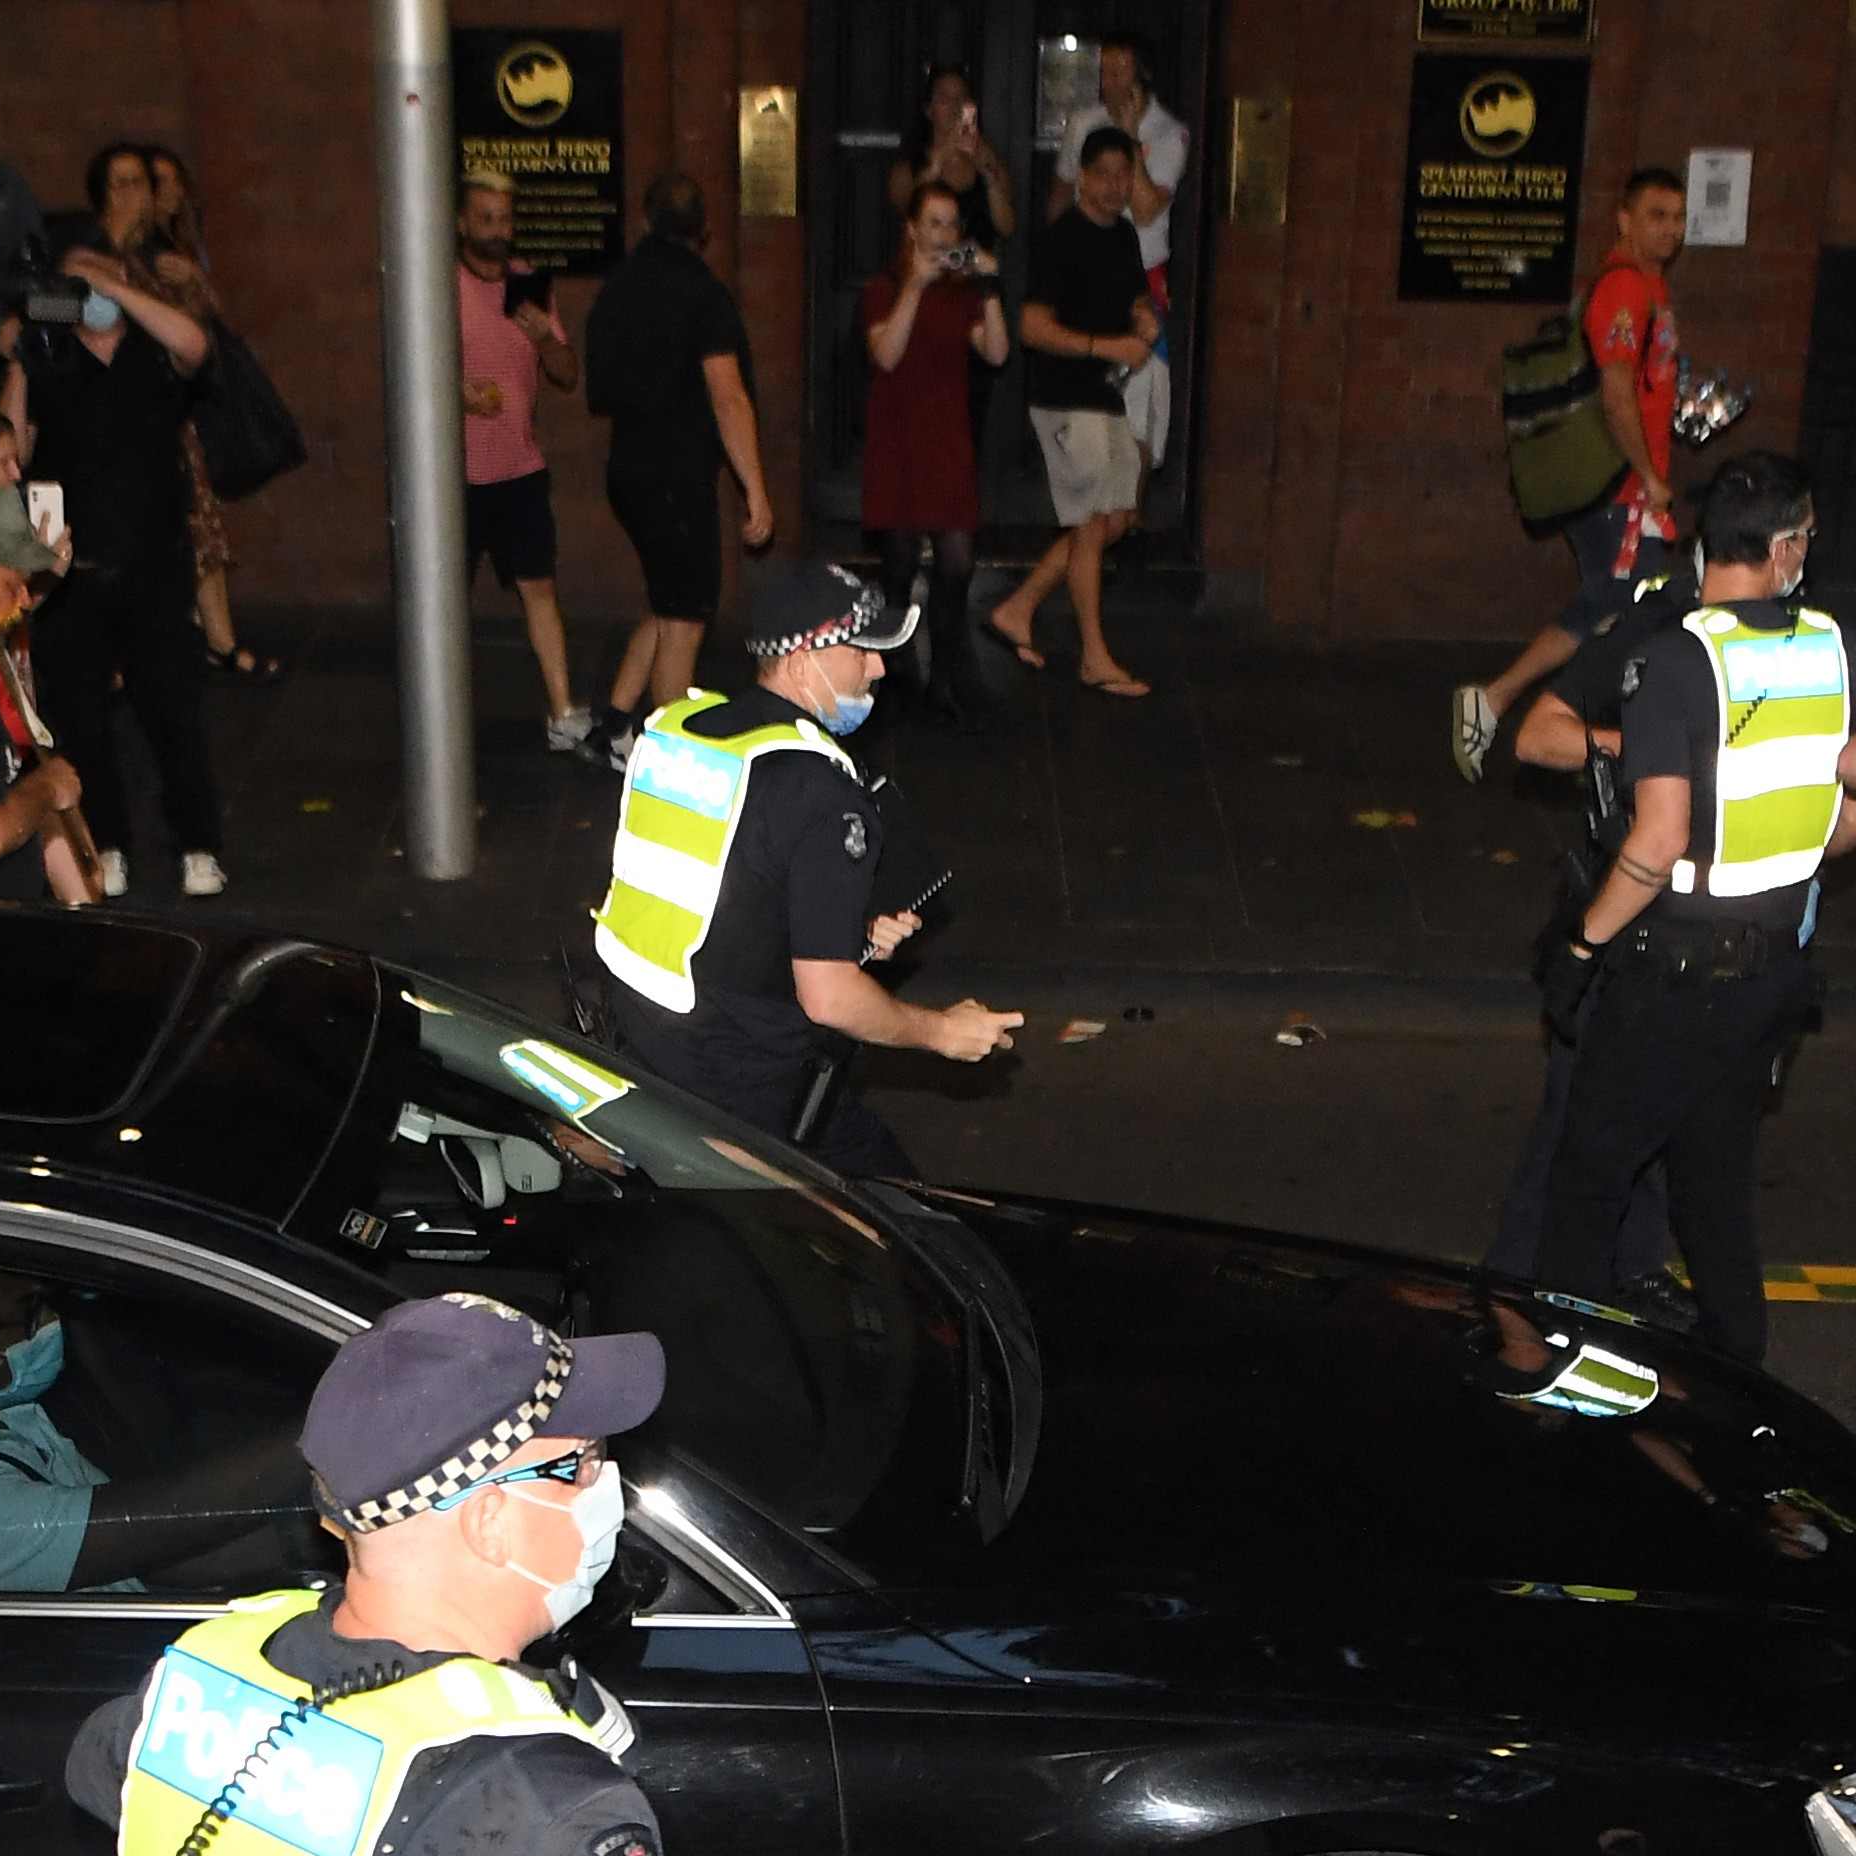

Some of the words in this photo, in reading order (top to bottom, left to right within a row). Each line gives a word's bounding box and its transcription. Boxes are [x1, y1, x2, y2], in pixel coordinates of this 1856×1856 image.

[1419, 165, 1510, 183] SPEARMINT
[1513, 166, 1567, 184] RHINO
[150, 1670, 360, 1836] Police
